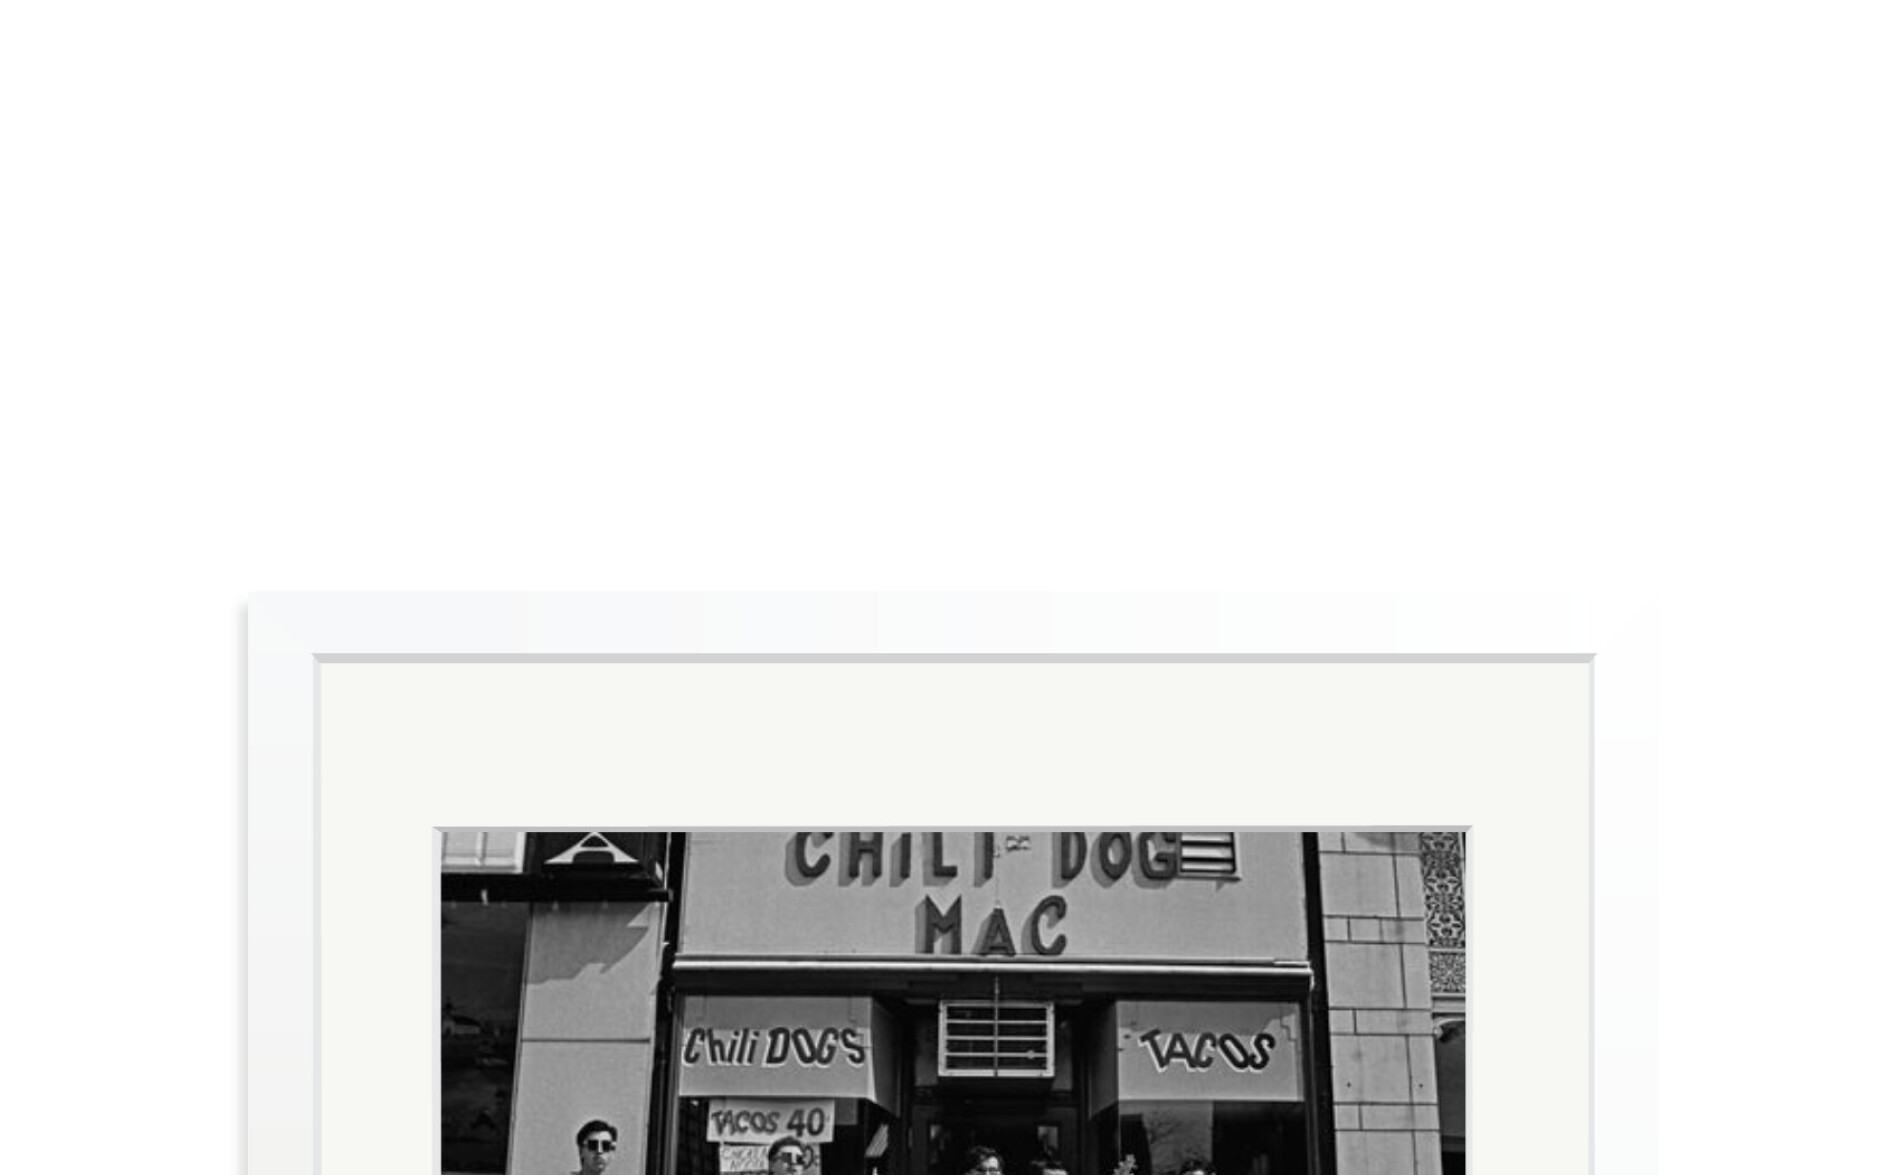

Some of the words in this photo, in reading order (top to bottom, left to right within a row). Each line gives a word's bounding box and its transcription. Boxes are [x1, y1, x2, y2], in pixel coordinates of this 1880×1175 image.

[787, 832, 995, 887] CHILI
[1054, 832, 1179, 889] DOG
[916, 895, 1067, 956] MAC
[683, 1027, 760, 1066] Chili
[763, 1027, 866, 1067] DOGS
[1139, 1029, 1276, 1071] TACOS
[711, 1109, 780, 1136] TACOS
[787, 1107, 826, 1138] 40
